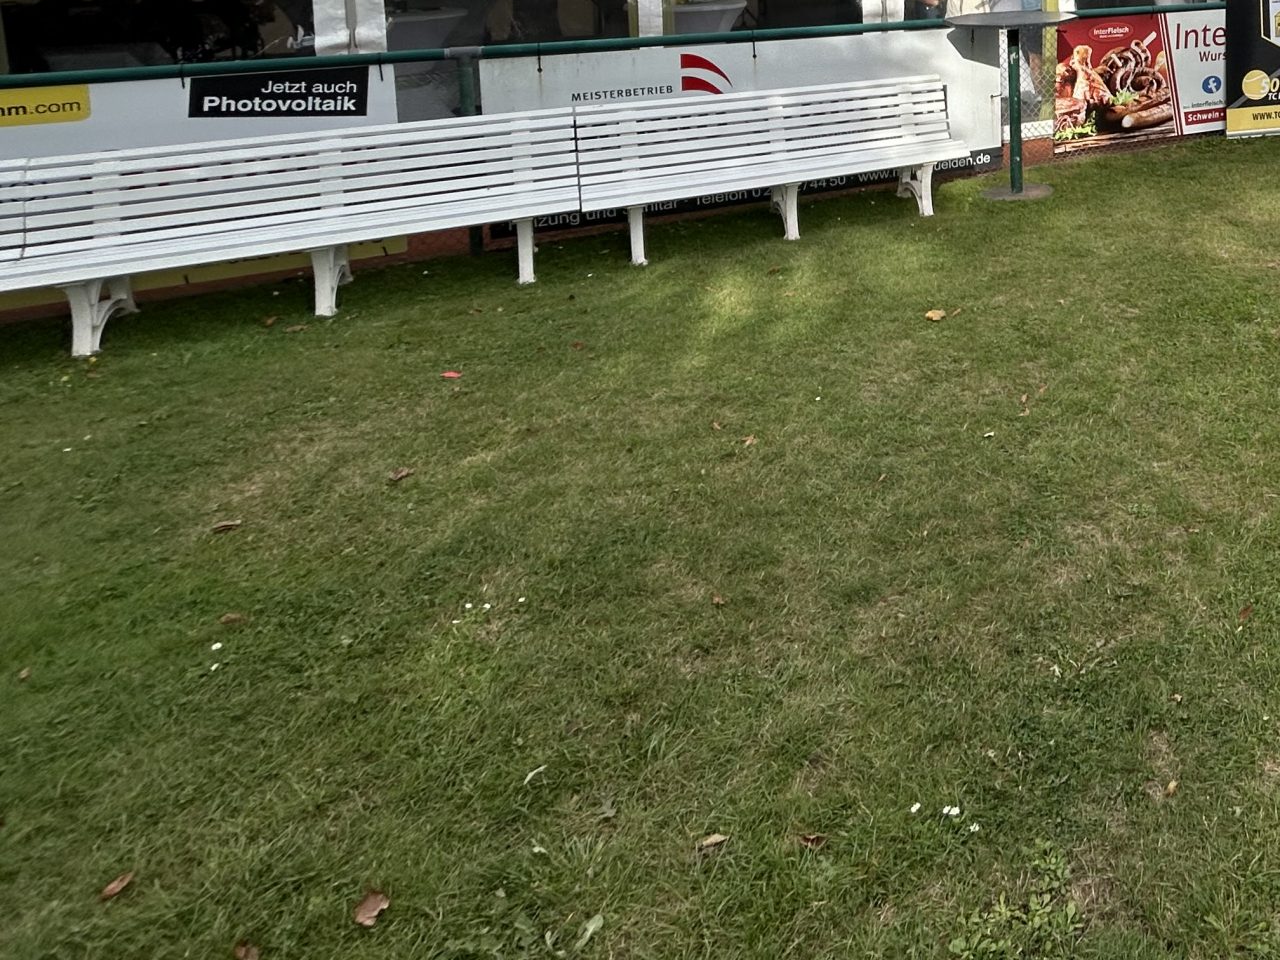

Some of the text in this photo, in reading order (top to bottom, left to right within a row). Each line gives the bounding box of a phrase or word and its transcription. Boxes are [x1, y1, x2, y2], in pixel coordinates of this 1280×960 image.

[261, 80, 357, 94] Jetzt auch
[571, 85, 674, 101] MEISTERBETRIEB
[1260, 77, 1280, 94] 50
[202, 96, 357, 113] Photovoltaik
[1188, 112, 1219, 121] Schwein
